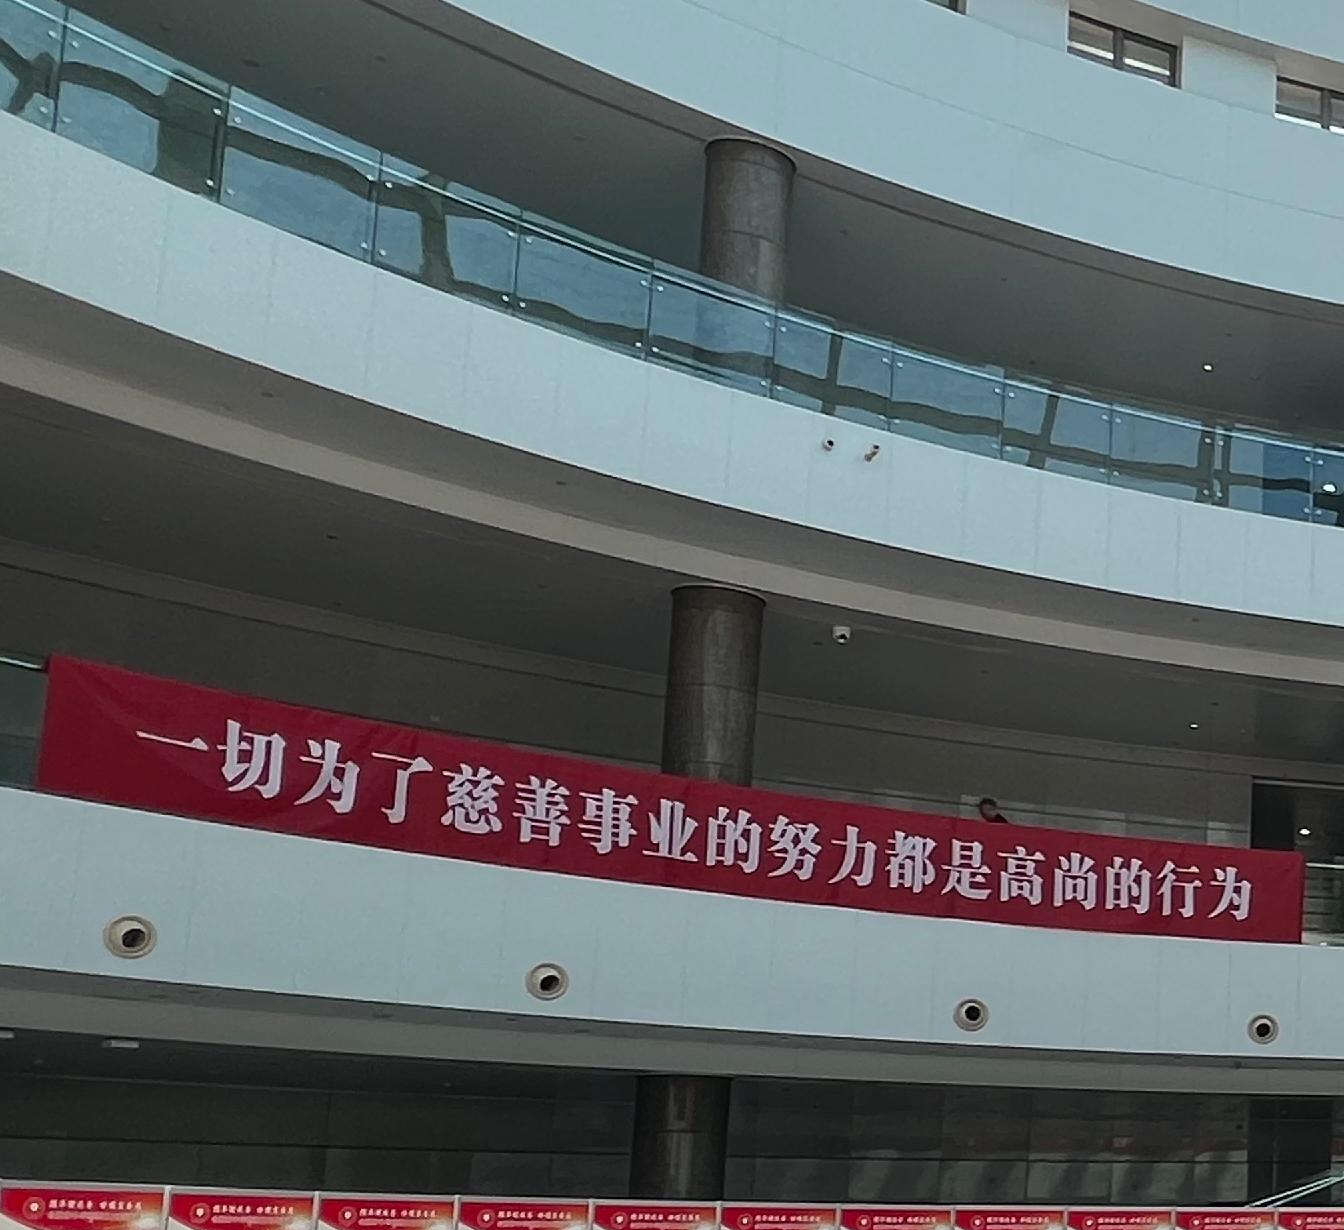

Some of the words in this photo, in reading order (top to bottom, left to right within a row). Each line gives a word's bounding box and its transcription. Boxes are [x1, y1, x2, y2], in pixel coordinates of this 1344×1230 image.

[136, 719, 1253, 921] 一切为了慈善事业的努力都是高尚的行为
